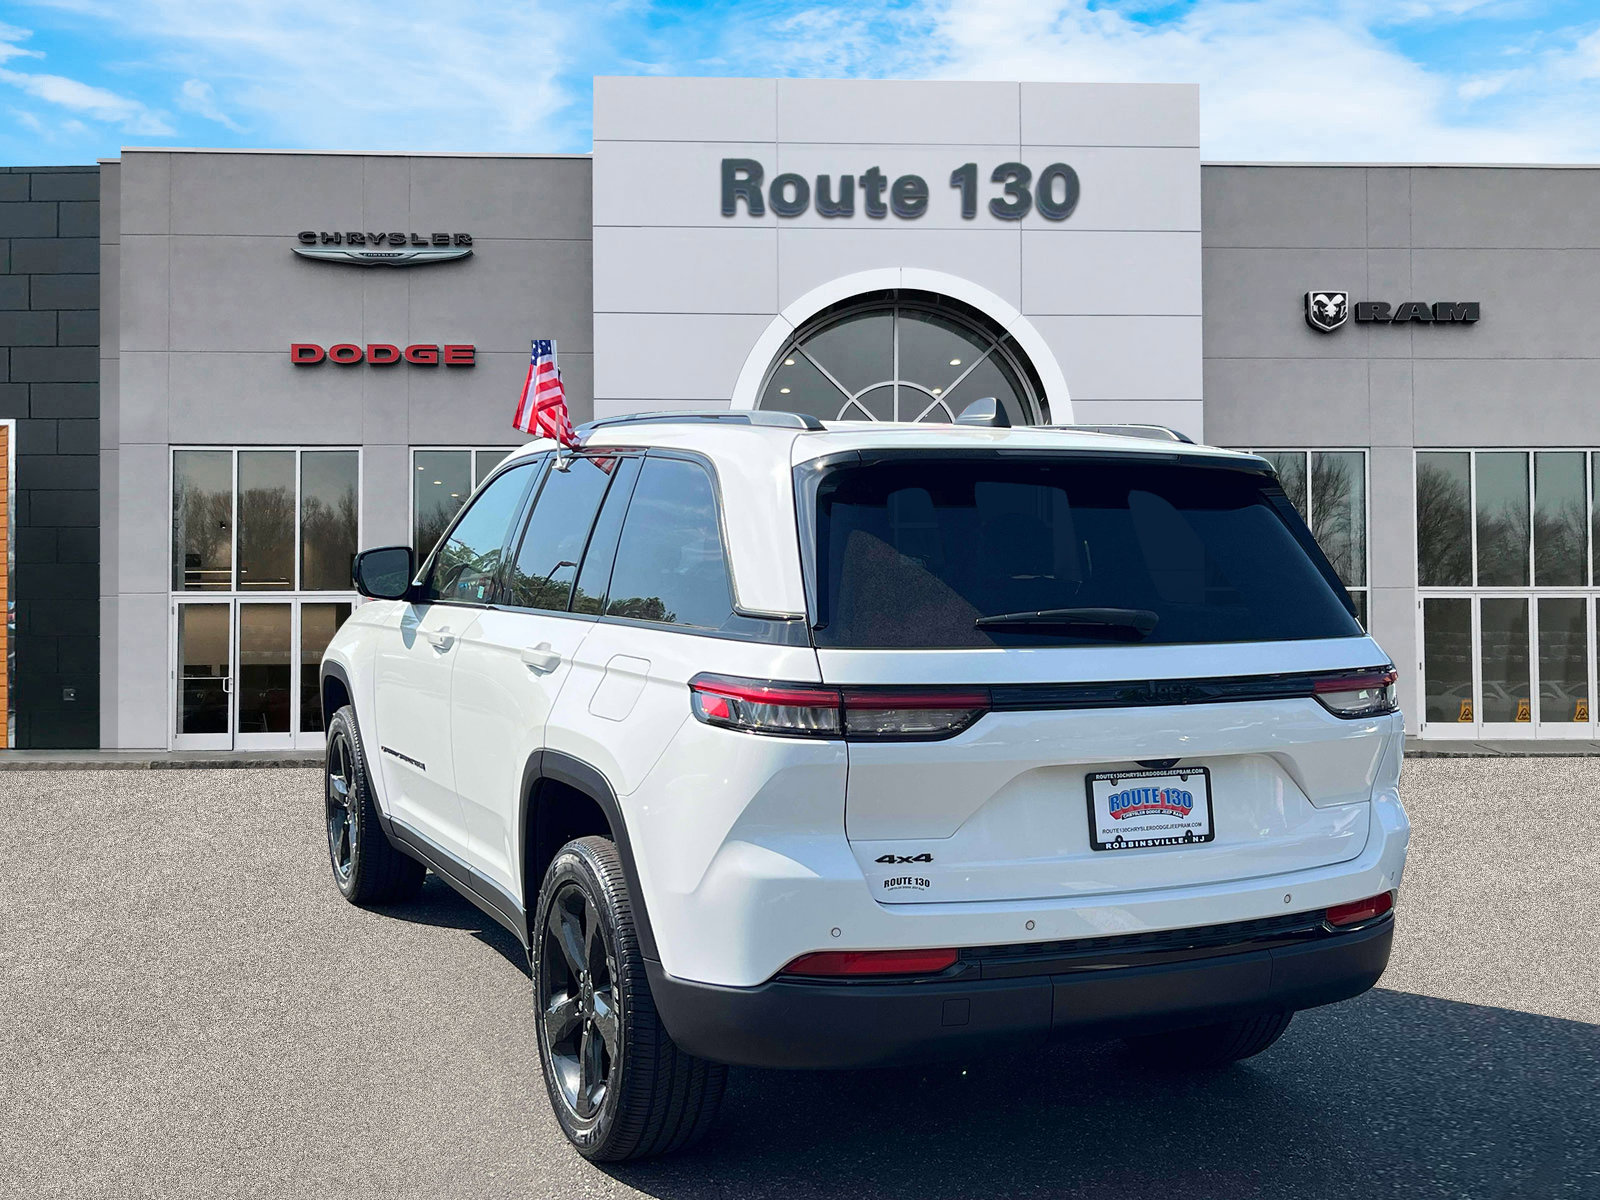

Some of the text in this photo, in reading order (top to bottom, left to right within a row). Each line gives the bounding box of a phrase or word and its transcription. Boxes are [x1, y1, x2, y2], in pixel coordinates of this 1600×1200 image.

[720, 157, 1080, 221] Route 130
[298, 231, 473, 246] CHRYSLER
[1354, 301, 1480, 323] RAM
[290, 343, 476, 366] DODGE
[1095, 768, 1204, 780] ROUTE130CHRYSLERDODGEJEEPRAM.COM
[1108, 787, 1193, 812] ROUTE 130
[1102, 822, 1202, 834] ROUTE130CHRYSLERDODGEJEEPRAM.COM
[875, 853, 934, 864] 4x4
[884, 877, 930, 888] ROUTE 130
